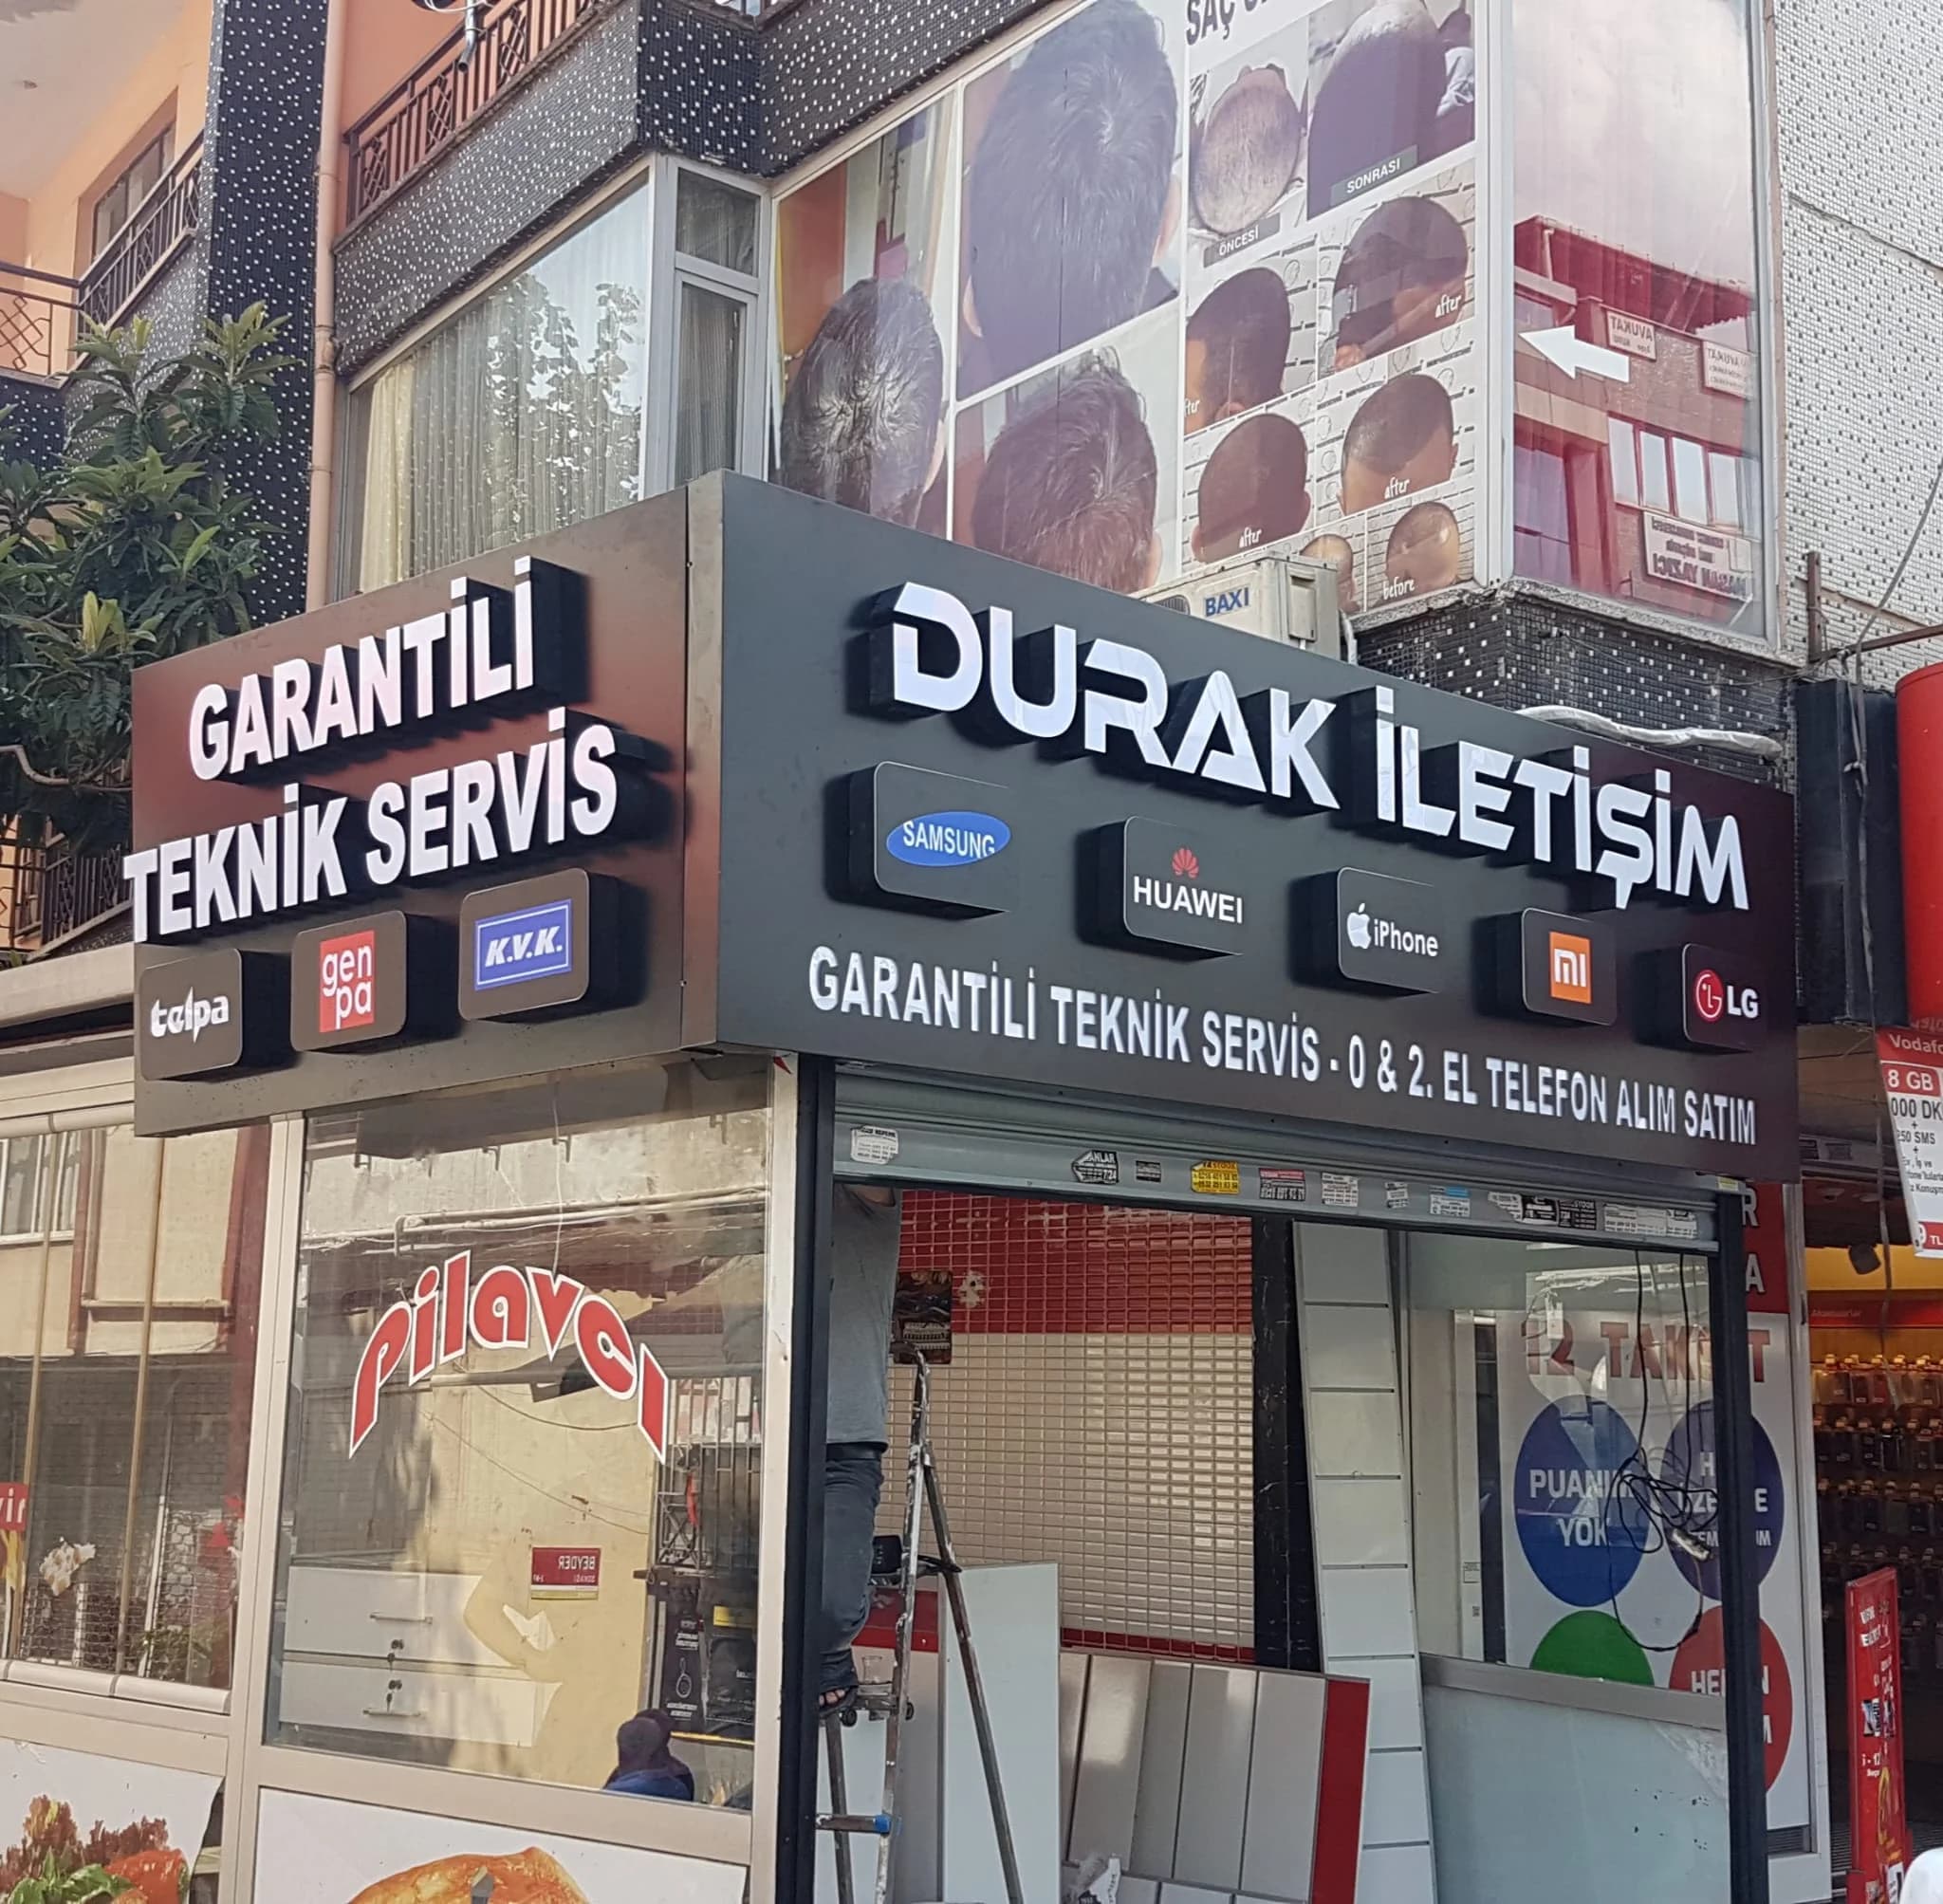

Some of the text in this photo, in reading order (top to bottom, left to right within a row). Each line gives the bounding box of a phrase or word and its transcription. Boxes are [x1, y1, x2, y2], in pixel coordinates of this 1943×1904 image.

[1346, 157, 1401, 194] SONRASI
[1218, 225, 1259, 256] ÖNCESİ
[1435, 293, 1462, 318] after
[1384, 477, 1410, 500] after
[1239, 527, 1262, 548] after
[1205, 587, 1249, 617] BAXI
[1381, 577, 1415, 601] before
[190, 556, 533, 781] GARANTİLİ
[893, 582, 1749, 910] DURAK İLETİŞİM
[123, 707, 617, 943] TEKNİK SERVİS
[902, 820, 996, 859] SAMSUNG
[1133, 876, 1244, 924] HUAWEI
[485, 925, 564, 968] K.V.K.
[1373, 919, 1438, 957] iPhone
[322, 945, 373, 997] gen
[150, 987, 231, 1044] telpa
[335, 984, 373, 1029] pa
[1728, 986, 1759, 1019] LG
[809, 946, 1037, 1041] GARANTİLİ
[1050, 988, 1191, 1063] TEKNİK
[1202, 1011, 1321, 1082] SERVİS
[1378, 1040, 1397, 1093] &
[1409, 1044, 1434, 1099] 2.
[1443, 1050, 1478, 1105] EL
[1486, 1057, 1608, 1124] TELEFON
[1616, 1079, 1677, 1135] ALIM
[1684, 1089, 1757, 1145] SATIM
[1906, 1071, 1934, 1091] GB
[1915, 1132, 1935, 1145] SMS
[1557, 1518, 1610, 1547] YOK
